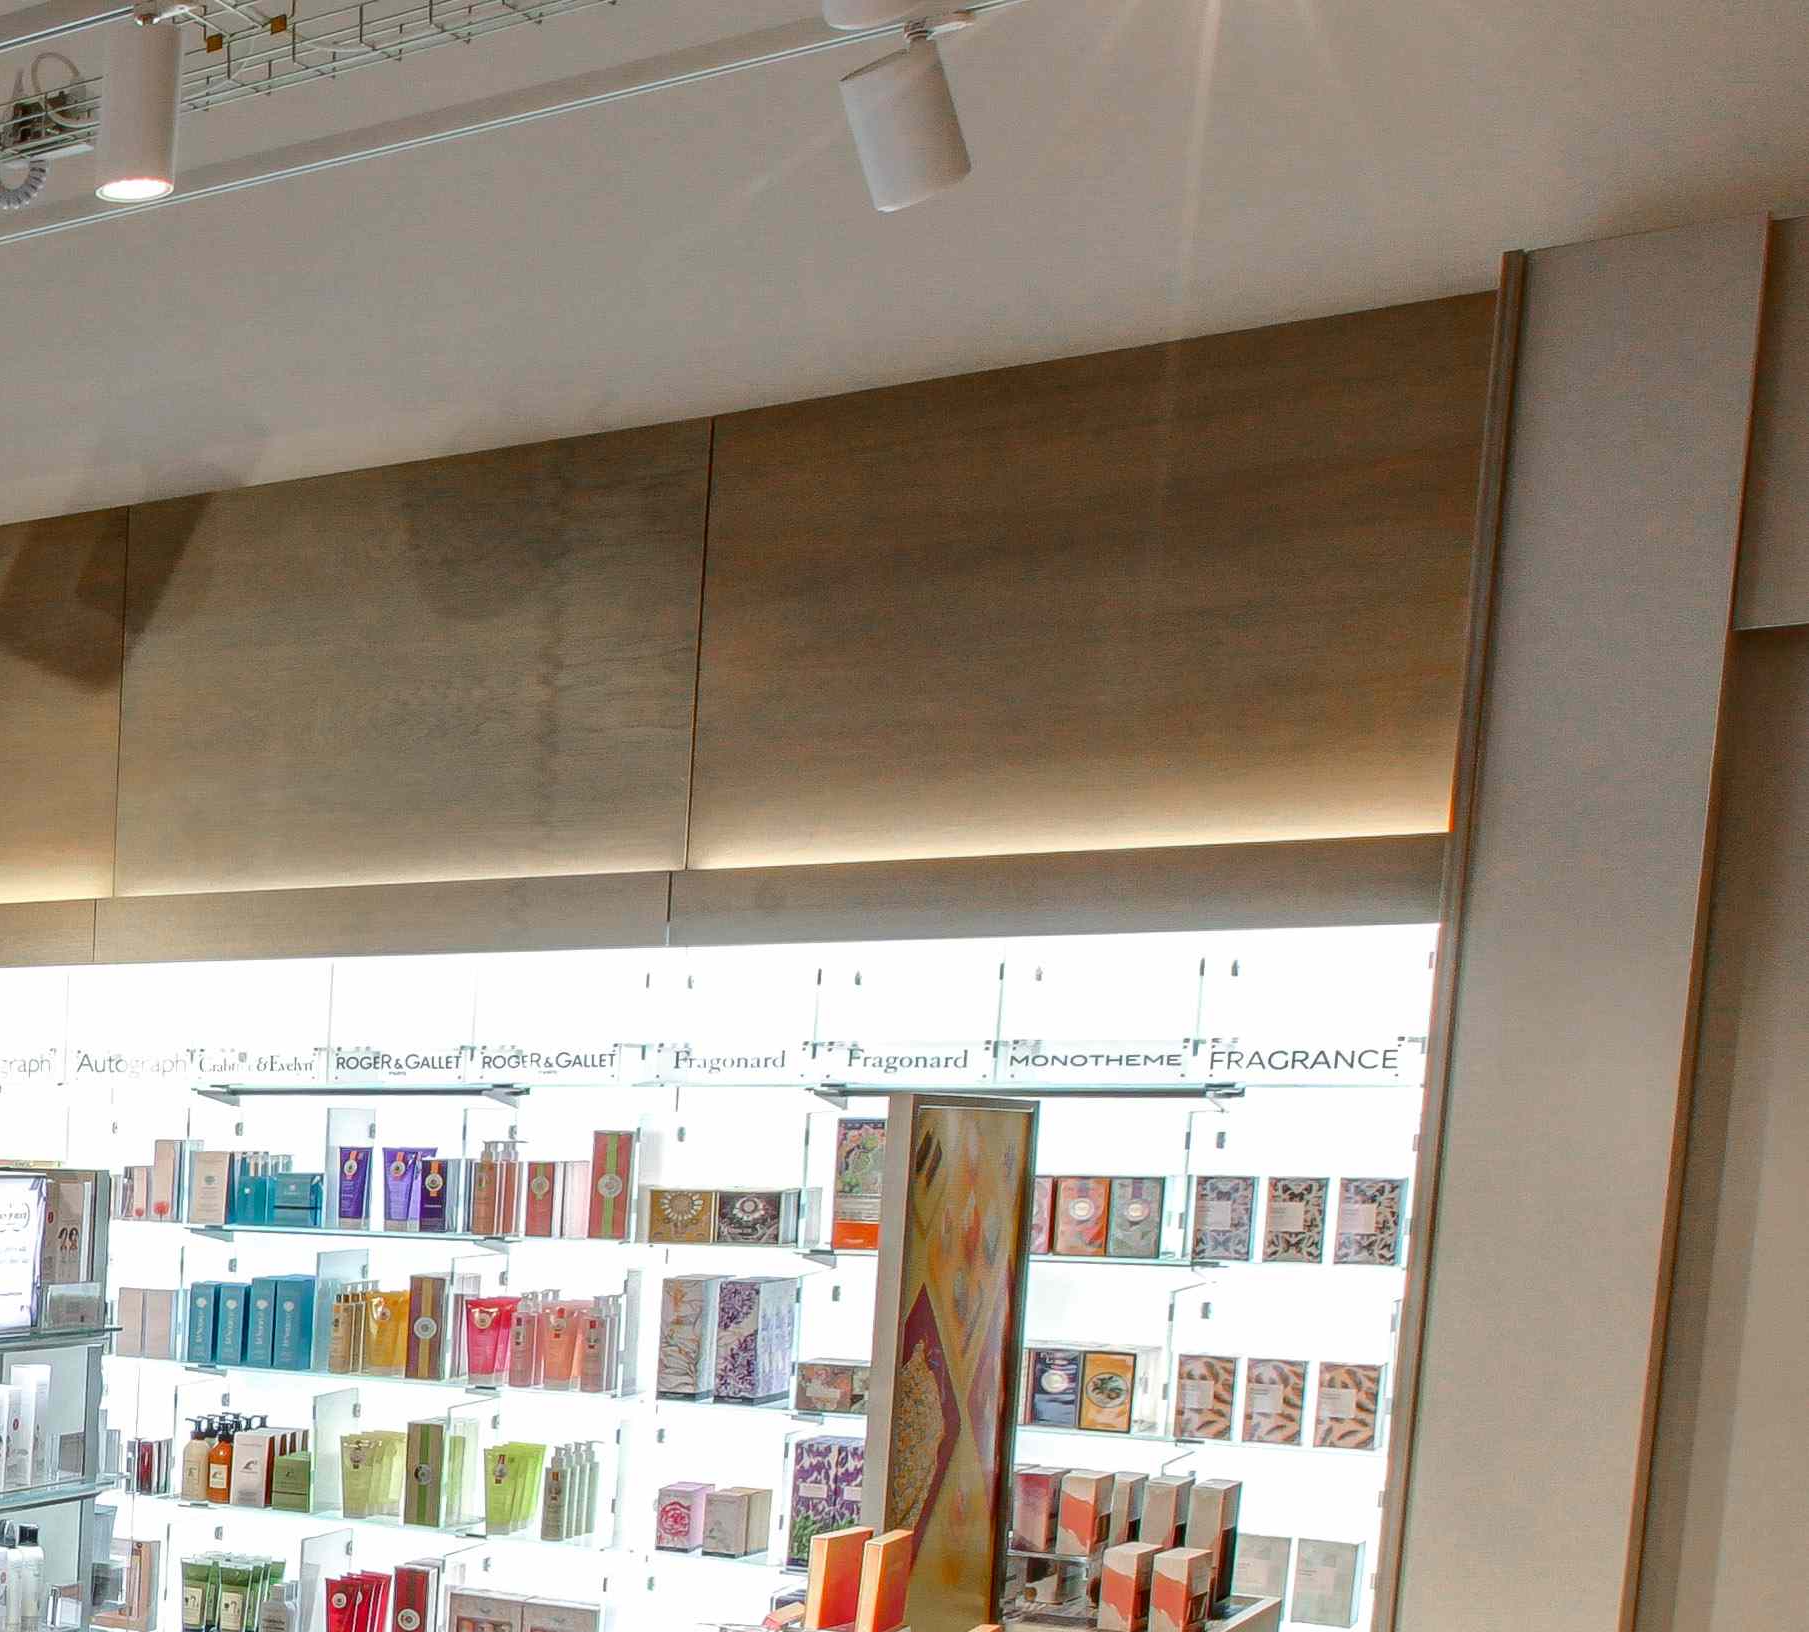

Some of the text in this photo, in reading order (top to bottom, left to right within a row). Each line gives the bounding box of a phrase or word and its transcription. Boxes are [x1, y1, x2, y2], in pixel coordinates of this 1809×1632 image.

[76, 1052, 187, 1079] Autograph
[336, 1053, 462, 1070] ROGER & GALLET
[481, 1052, 616, 1069] ROGER & GALLET
[673, 1049, 786, 1074] Fragonard
[846, 1047, 968, 1073] Fragonard
[1009, 1053, 1182, 1067] MONOTHEME
[1210, 1048, 1398, 1071] FRAGRANCE
